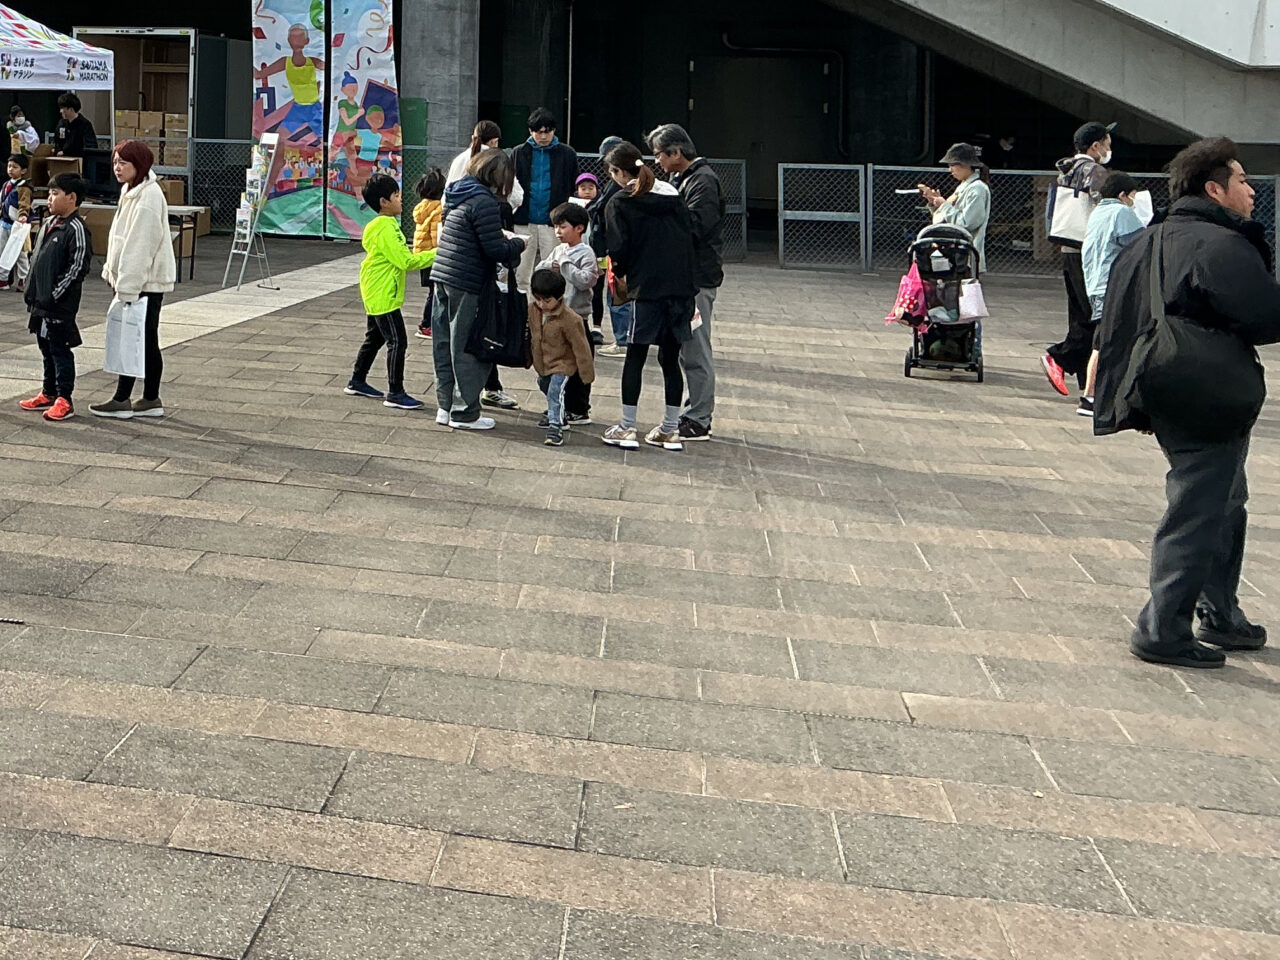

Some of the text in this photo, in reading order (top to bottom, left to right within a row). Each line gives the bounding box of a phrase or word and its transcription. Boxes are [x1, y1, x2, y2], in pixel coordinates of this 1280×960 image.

[13, 57, 35, 68] さいたま
[13, 69, 35, 80] マラソン
[79, 72, 108, 82] MARATHON
